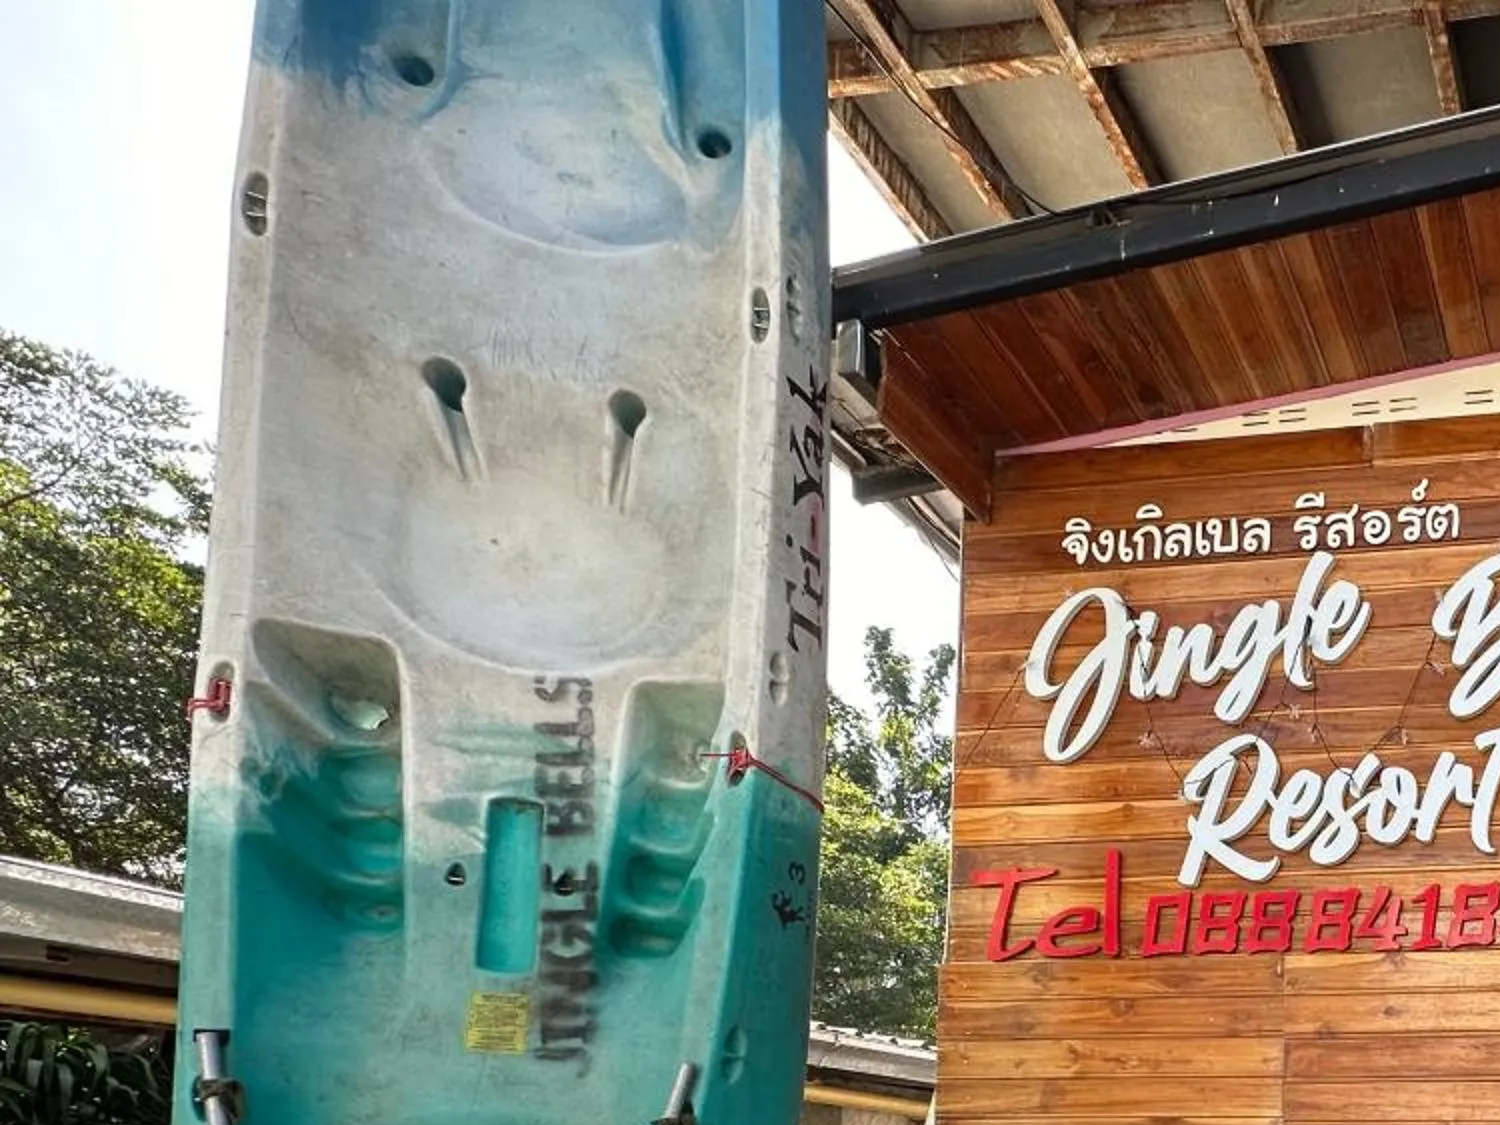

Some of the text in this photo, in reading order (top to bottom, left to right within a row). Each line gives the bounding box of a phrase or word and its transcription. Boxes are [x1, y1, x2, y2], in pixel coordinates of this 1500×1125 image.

[1061, 478, 1460, 565] จิงเกิลเบล รีสอร์ต
[1024, 551, 1371, 765] Jingle
[970, 847, 1123, 962] Tel
